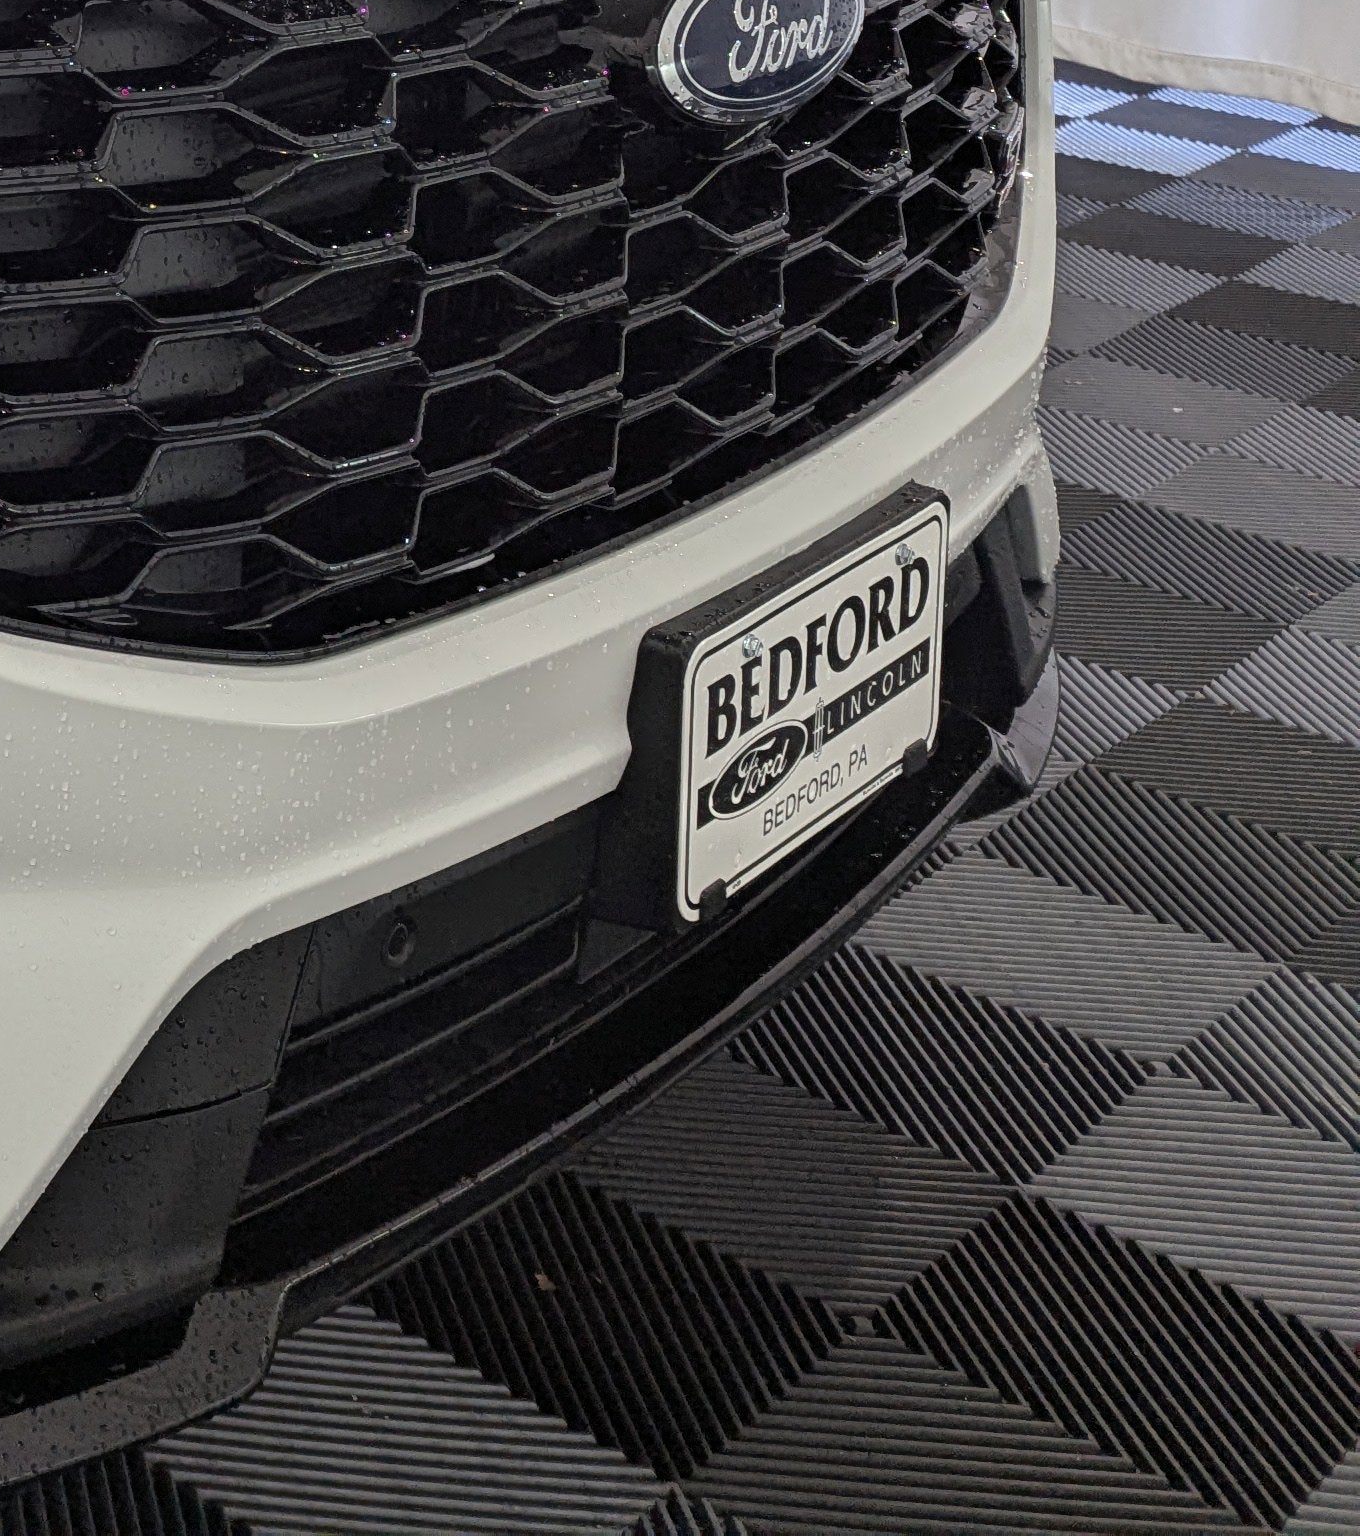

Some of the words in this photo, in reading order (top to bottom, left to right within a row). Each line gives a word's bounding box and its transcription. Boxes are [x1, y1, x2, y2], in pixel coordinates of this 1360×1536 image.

[705, 556, 930, 760] BEDFORD
[826, 651, 923, 736] LINCOLN
[730, 735, 789, 806] Ford
[762, 762, 845, 837] BEDFORD,
[848, 743, 869, 778] PA
